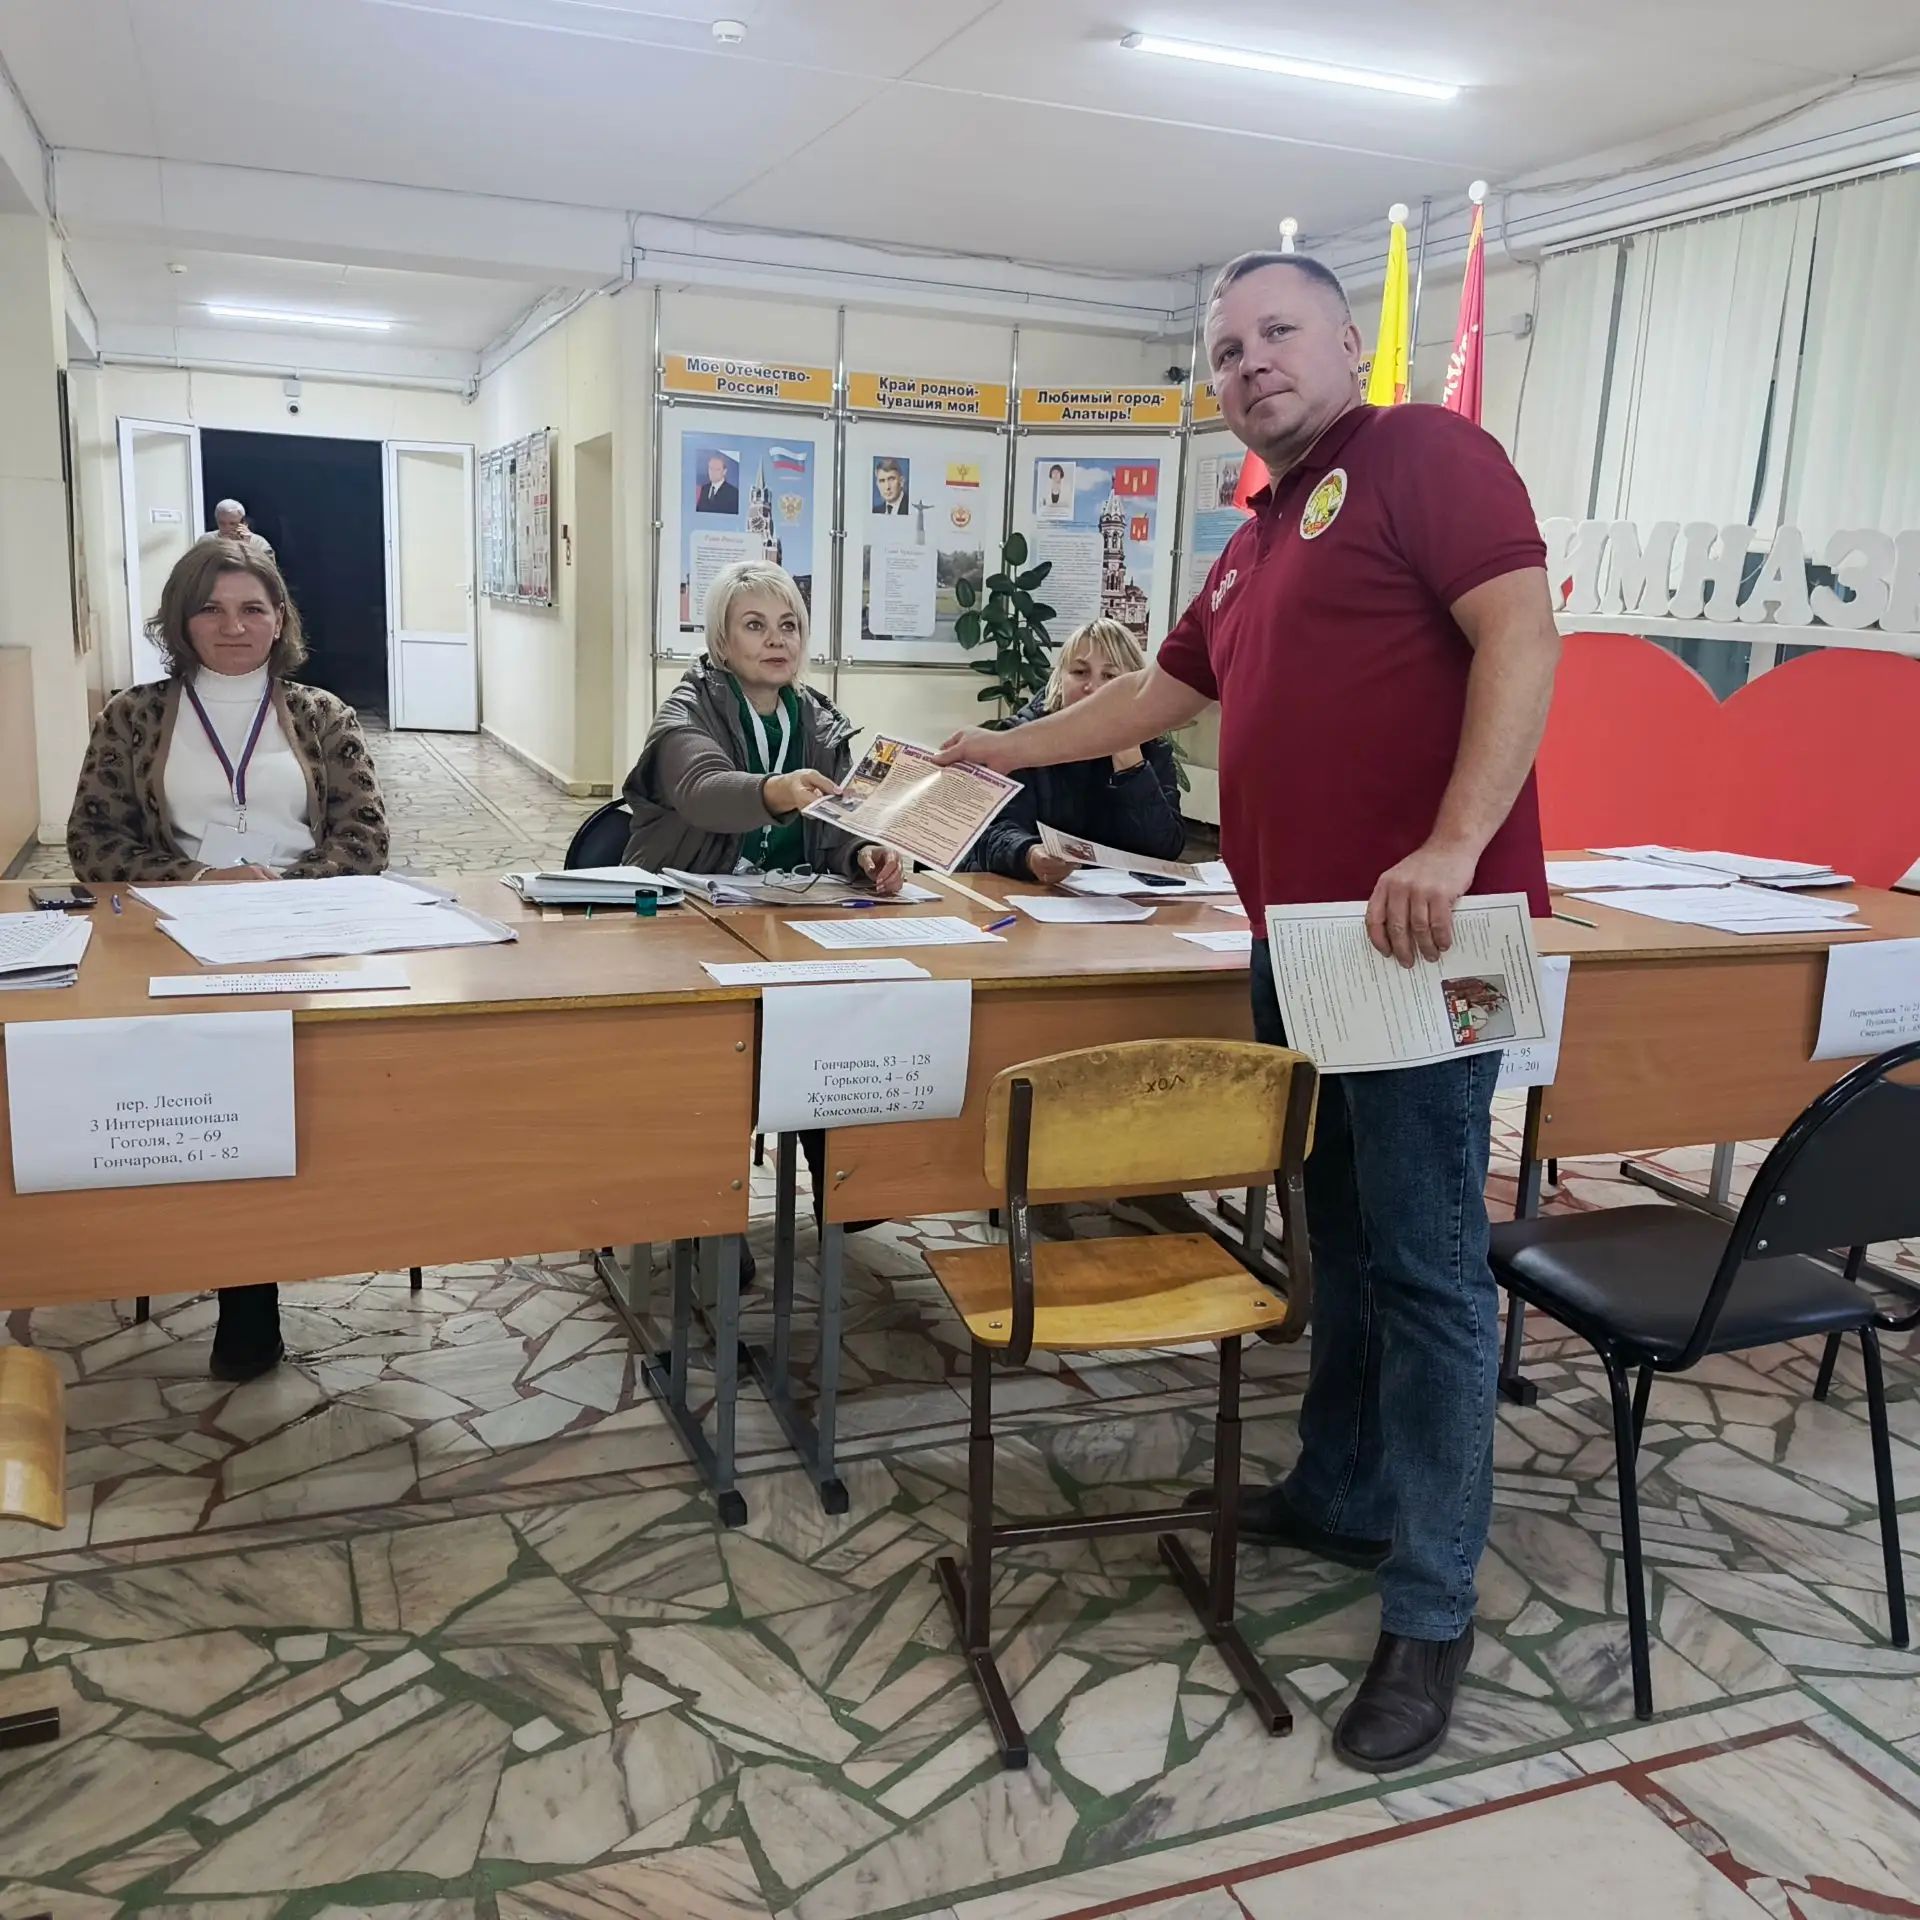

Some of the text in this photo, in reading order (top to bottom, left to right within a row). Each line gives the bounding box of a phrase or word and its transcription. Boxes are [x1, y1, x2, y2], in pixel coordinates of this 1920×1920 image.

[687, 357, 811, 382] Мое Отечество-
[717, 378, 779, 396] Россия!
[879, 376, 979, 397] Край родной-
[876, 392, 980, 413] Чувашия моя!
[1038, 391, 1165, 408] Любимый город-
[1061, 407, 1131, 421] Алатырь!
[1542, 517, 1920, 631] ИМНАЗ
[814, 1058, 879, 1071] Гончарова,
[883, 1056, 896, 1066] 83
[911, 1054, 931, 1065] 128
[1521, 1048, 1531, 1058] 95
[1525, 1062, 1539, 1071] 20)
[824, 1073, 881, 1087] Горького,
[885, 1073, 892, 1082] 4
[906, 1071, 919, 1081] 65
[116, 1093, 212, 1112] пер. Лесной
[807, 1089, 882, 1104] Жуковского,
[886, 1087, 900, 1097] 68
[915, 1085, 933, 1096] 119
[813, 1104, 882, 1118] Комсомола,
[886, 1102, 900, 1112] 48
[912, 1101, 924, 1111] 72
[90, 1111, 238, 1132] 3 Интернационала
[110, 1134, 170, 1150] Гоголя,
[176, 1132, 184, 1144] 2
[204, 1130, 222, 1142] 69
[93, 1152, 182, 1169] Гончарова,
[188, 1150, 204, 1162] 61
[222, 1147, 239, 1159] 82
